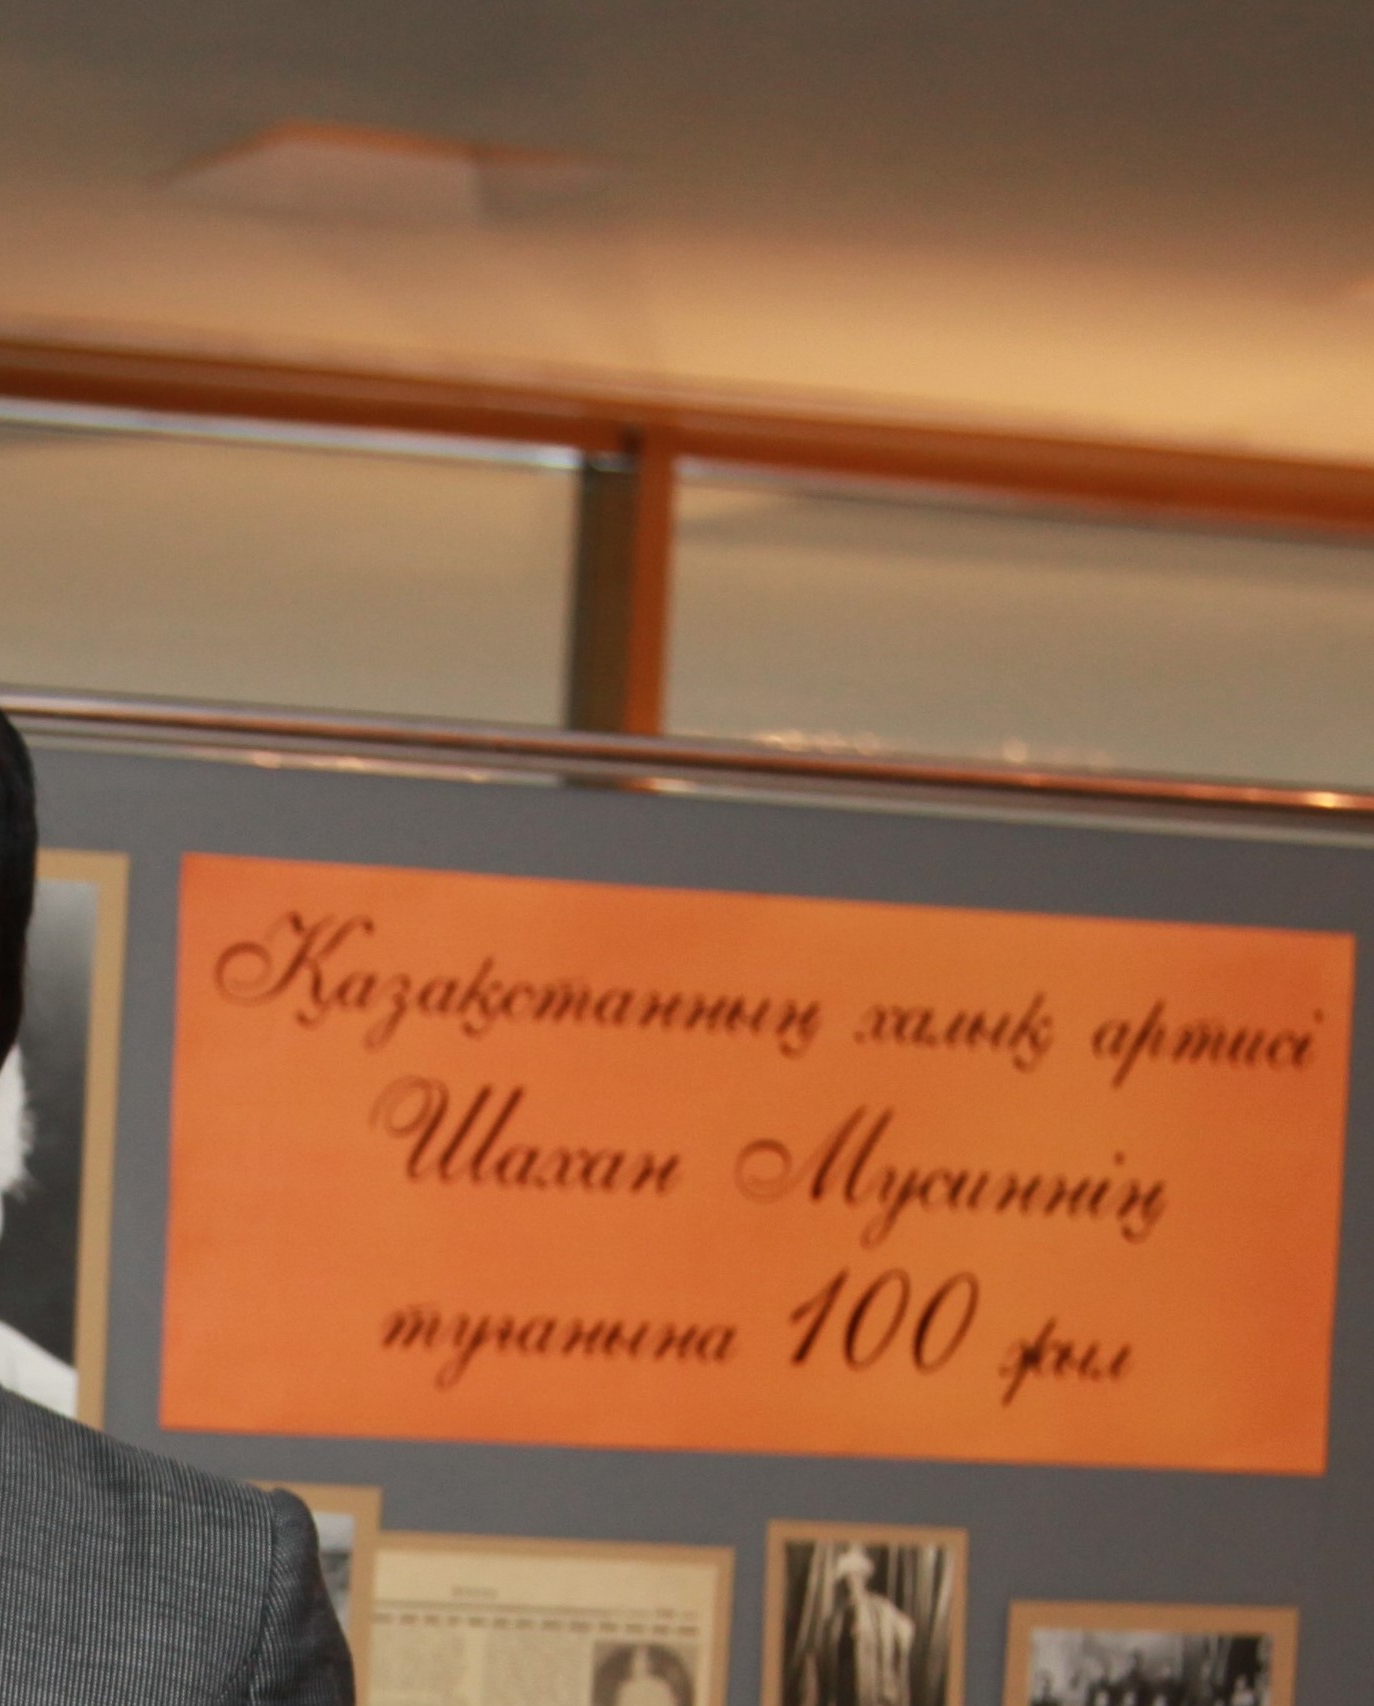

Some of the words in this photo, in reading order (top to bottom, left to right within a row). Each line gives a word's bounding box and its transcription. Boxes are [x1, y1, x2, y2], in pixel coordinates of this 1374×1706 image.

[213, 911, 823, 1060] Қазақстанның
[852, 990, 1053, 1074] халық
[1090, 998, 1326, 1091] артисі
[366, 1074, 682, 1198] Шахан
[731, 1104, 1167, 1252] Мусиннің
[379, 1303, 738, 1393] туғанына
[788, 1266, 981, 1377] 100
[998, 1314, 1132, 1408] жыл
